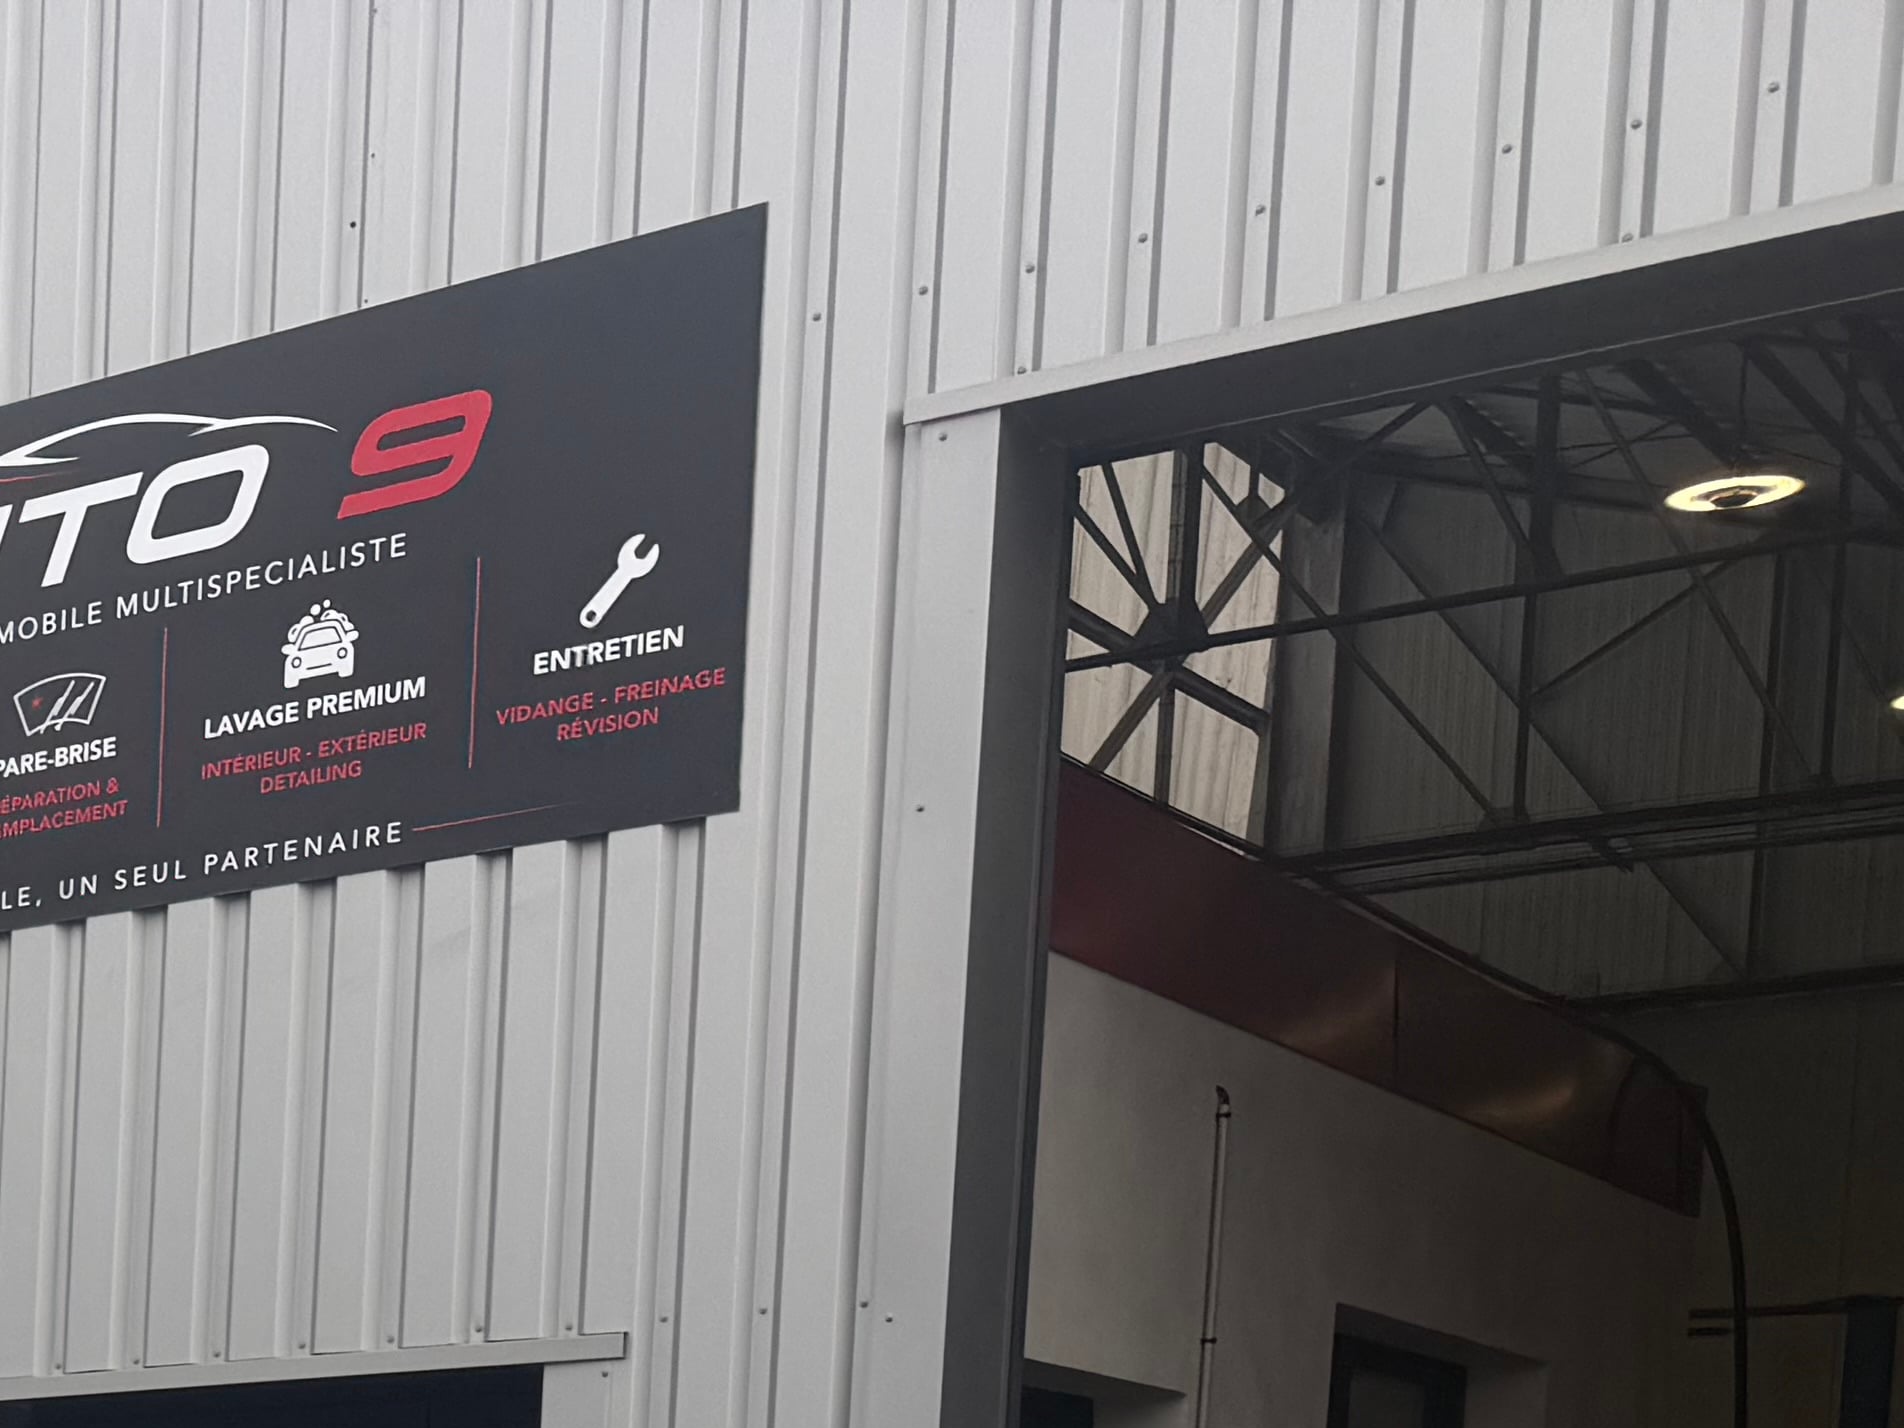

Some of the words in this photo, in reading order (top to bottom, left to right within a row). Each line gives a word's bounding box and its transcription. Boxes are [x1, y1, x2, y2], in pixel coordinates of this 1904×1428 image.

[337, 389, 493, 519] 9
[115, 533, 407, 619] MULTISPECIALISTE
[533, 625, 684, 675] ENTRETIEN
[204, 701, 299, 739] LAVAGE
[307, 676, 426, 719] PREMIUM
[496, 692, 593, 727] VIDANGE
[615, 667, 726, 704] FREINAGE
[557, 707, 659, 741] RÉVISION
[201, 746, 301, 780] INTÉRIEUR
[319, 722, 427, 758] EXTÉRIEUR
[260, 760, 362, 794] DETAILING
[106, 777, 119, 794] &
[59, 874, 98, 900] UN
[114, 860, 186, 890] SEUL
[204, 822, 403, 875] PARTENAIRE
